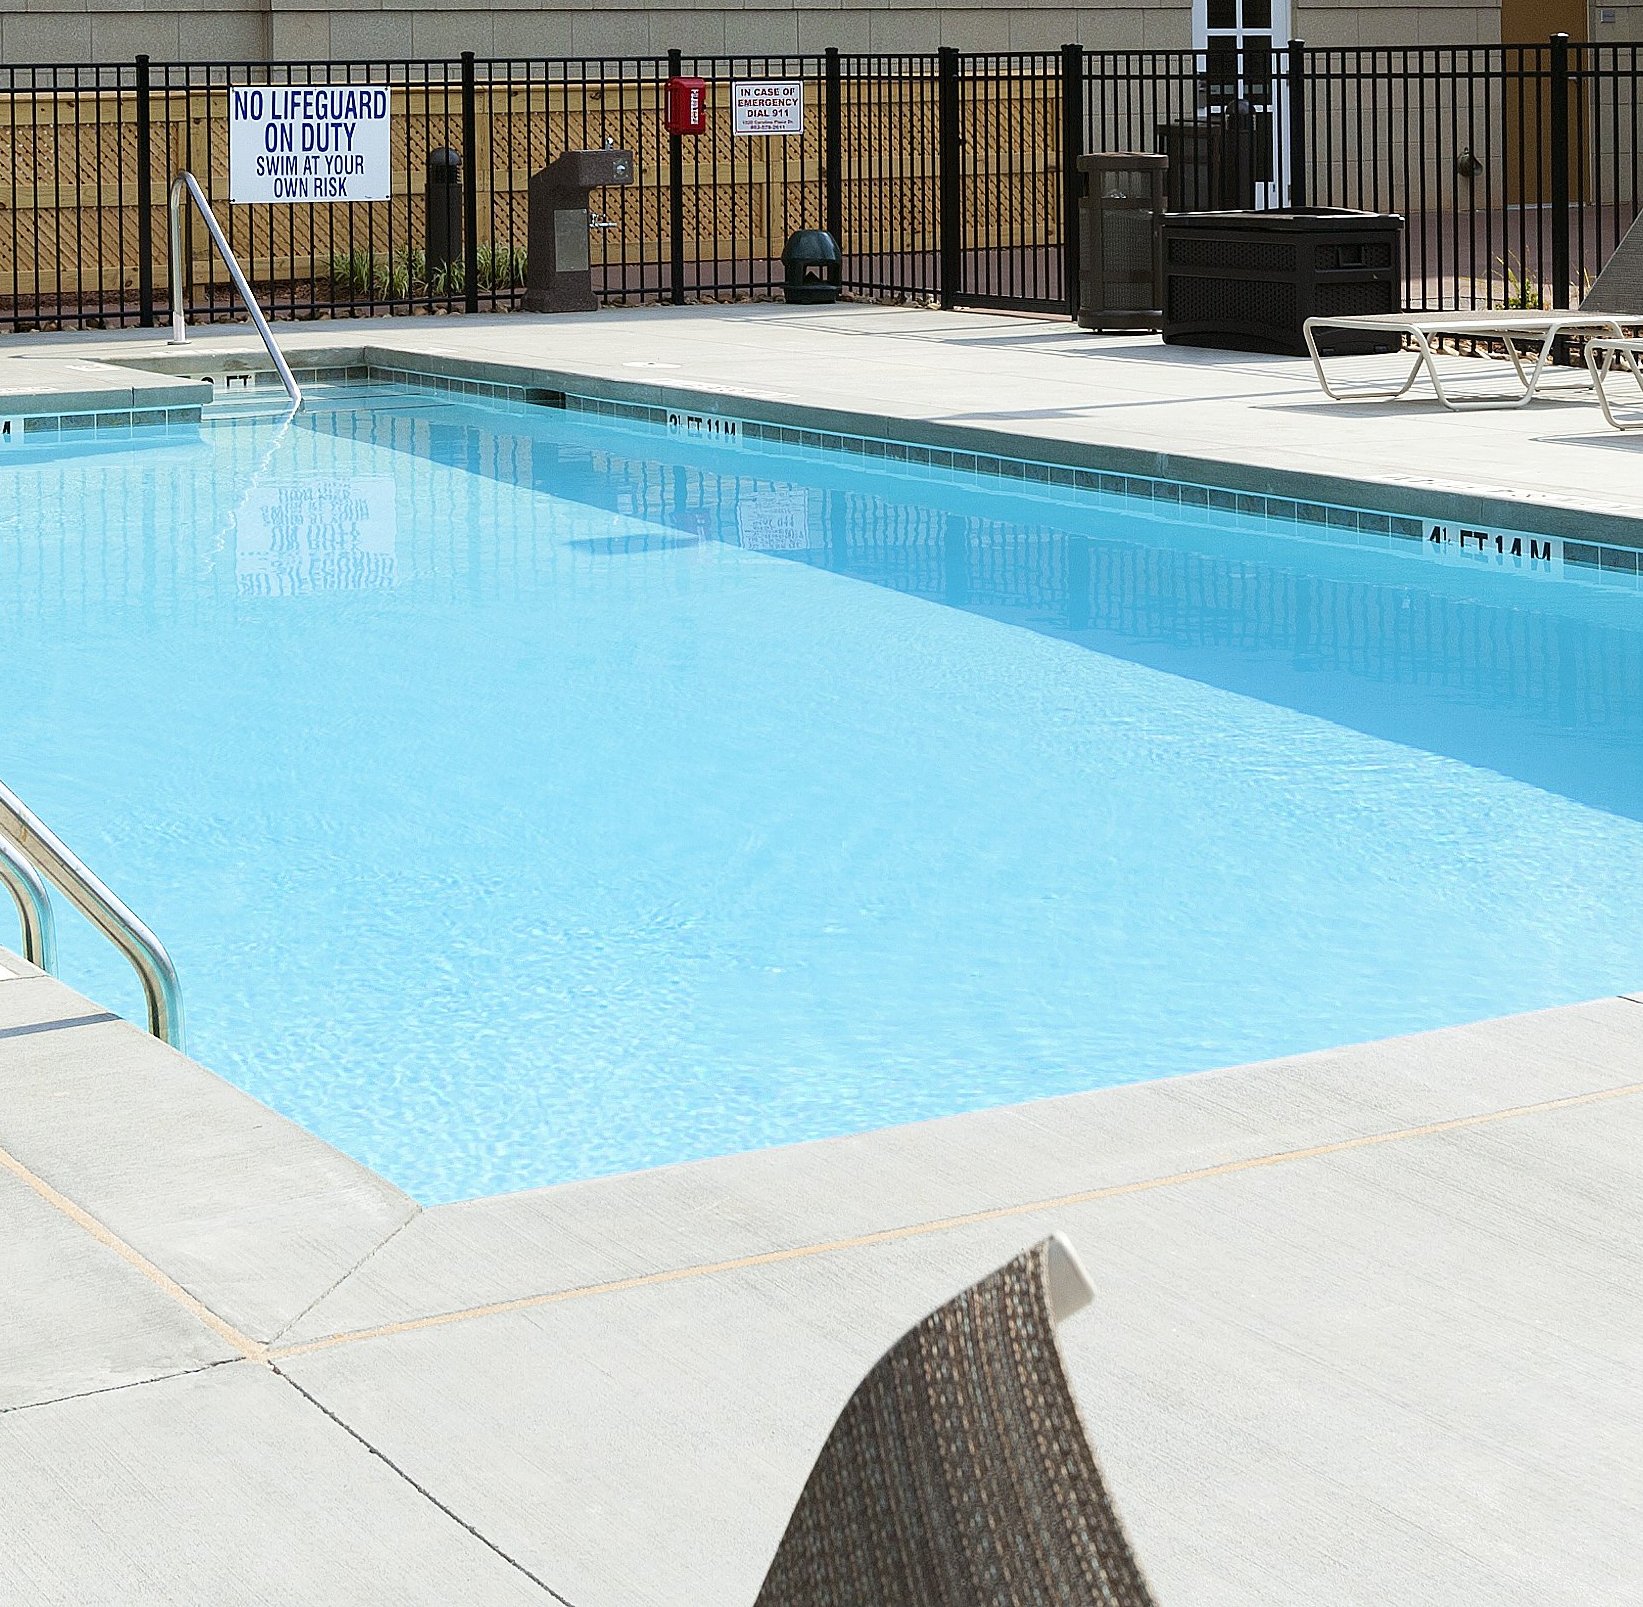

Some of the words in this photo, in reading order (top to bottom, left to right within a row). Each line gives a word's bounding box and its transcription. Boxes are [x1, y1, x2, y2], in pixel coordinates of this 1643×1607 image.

[738, 98, 798, 107] EMERGENCY
[740, 88, 751, 96] IN
[754, 88, 780, 96] CASE
[782, 87, 795, 96] OF
[235, 90, 263, 120] NO
[271, 90, 386, 120] LIFEGUARD
[747, 109, 769, 117] DIAL
[772, 109, 789, 117] 911
[265, 122, 293, 153] ON
[301, 122, 356, 152] DUTY
[256, 155, 298, 177] SWIM
[303, 155, 320, 176] AT
[325, 154, 364, 175] YOUR
[274, 177, 308, 198] OWN
[314, 176, 348, 197] RISK
